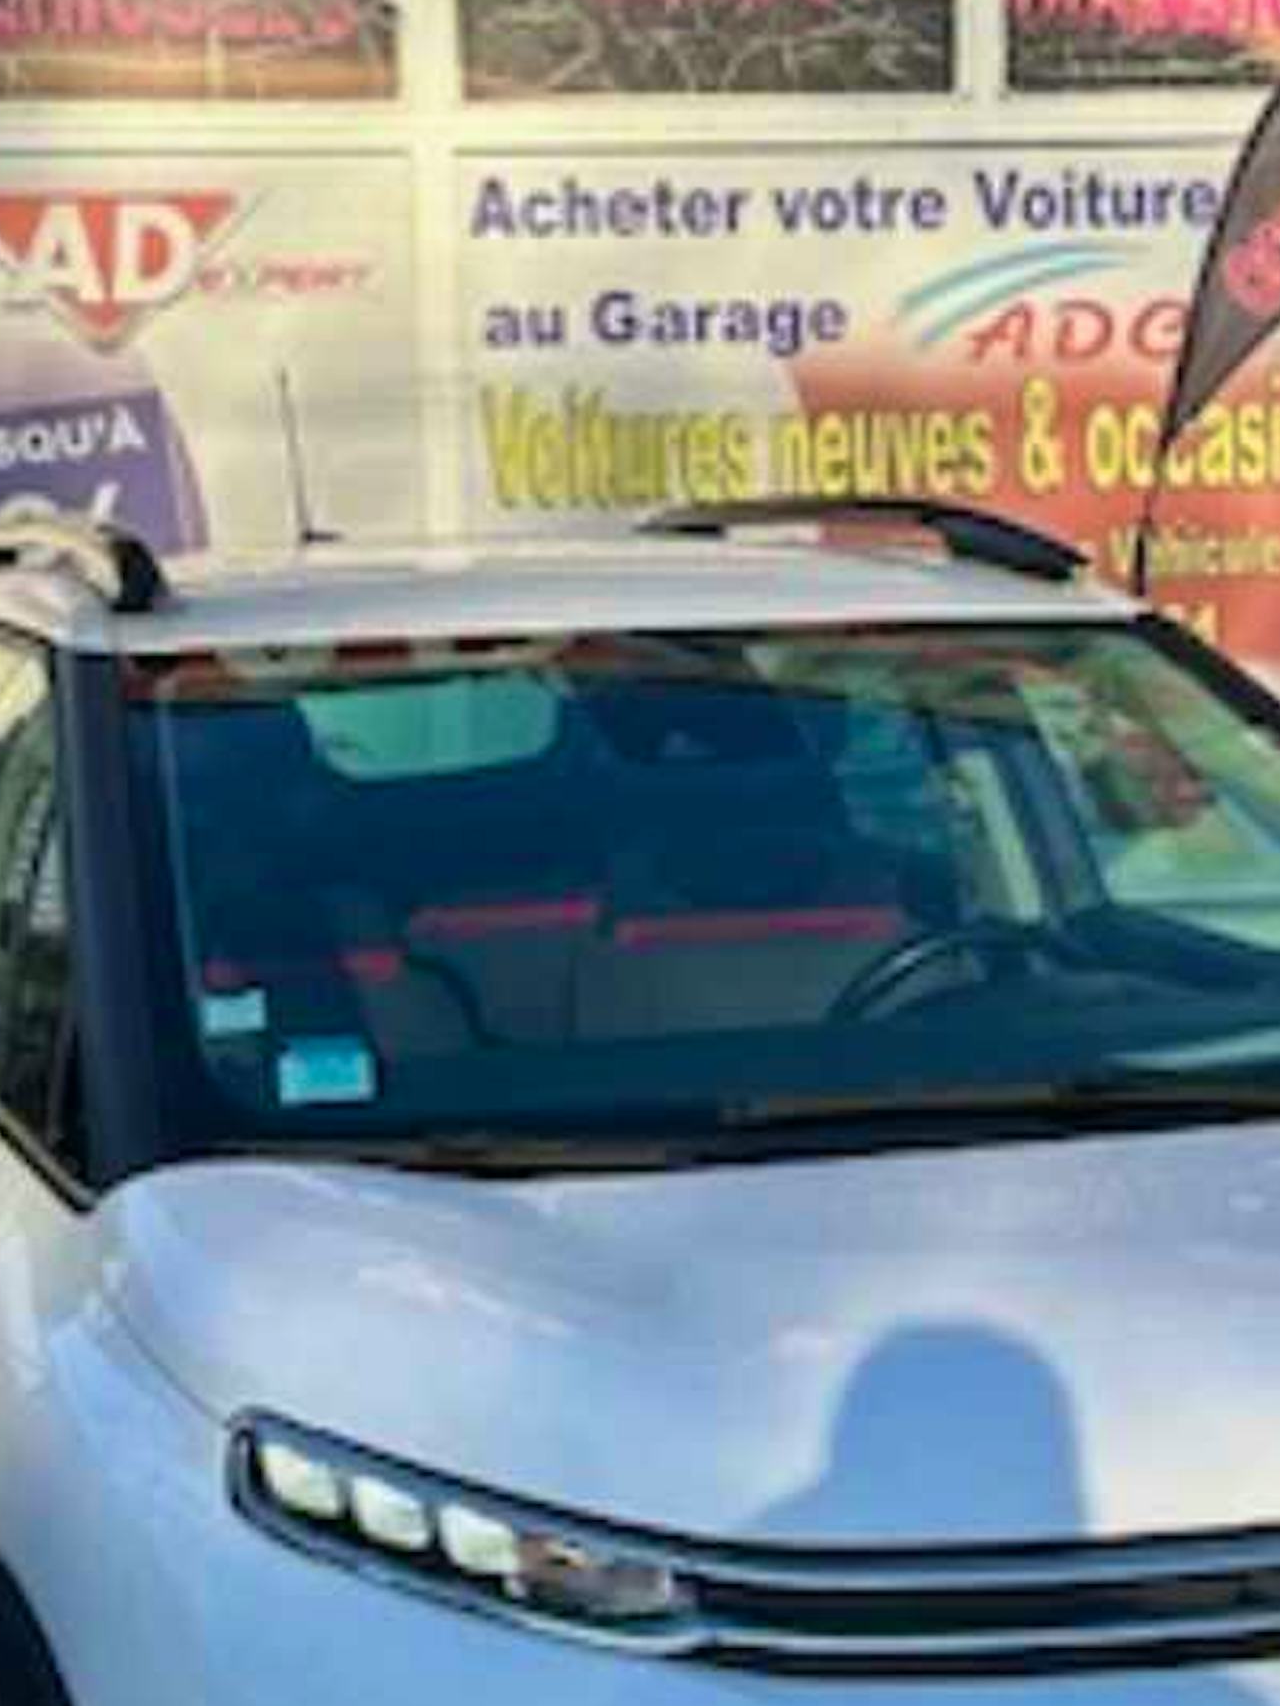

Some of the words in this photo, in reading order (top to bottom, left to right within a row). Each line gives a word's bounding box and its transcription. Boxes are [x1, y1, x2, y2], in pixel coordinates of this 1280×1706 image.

[471, 175, 745, 238] Acheter
[770, 175, 949, 233] votre
[973, 170, 1220, 230] Voiture
[7, 197, 197, 305] AD
[485, 299, 565, 346] au
[590, 290, 847, 357] Garage
[481, 387, 754, 509] Voitures
[768, 399, 994, 497] neuves
[1022, 379, 1066, 488] &
